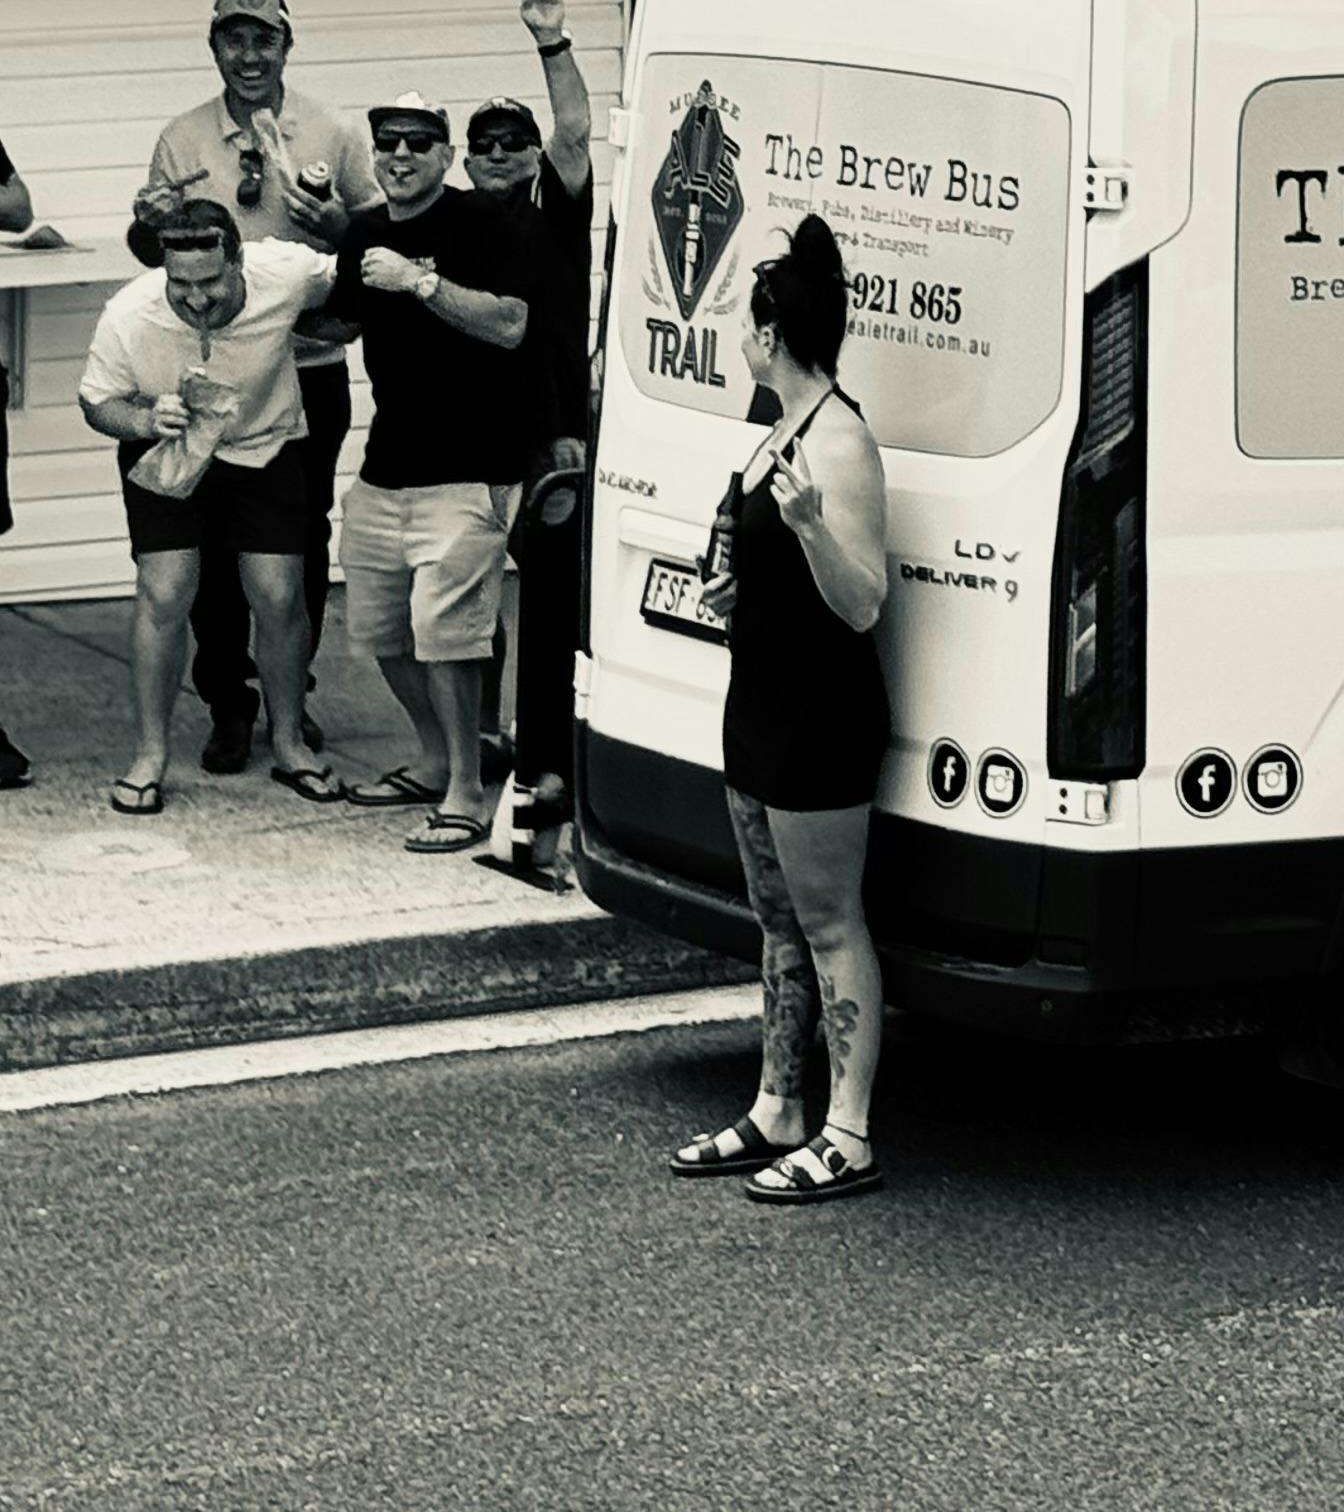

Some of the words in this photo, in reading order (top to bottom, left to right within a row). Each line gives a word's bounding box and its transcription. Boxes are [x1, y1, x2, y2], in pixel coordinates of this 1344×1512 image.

[765, 134, 823, 180] The
[836, 145, 932, 198] Brew
[944, 159, 1019, 210] Bus
[853, 272, 898, 315] 921
[910, 281, 962, 324] 865
[646, 318, 726, 388] TRAIL
[847, 318, 991, 357] ealetrail.com.au
[900, 563, 997, 593] DELIVER
[1005, 579, 1018, 603] 9
